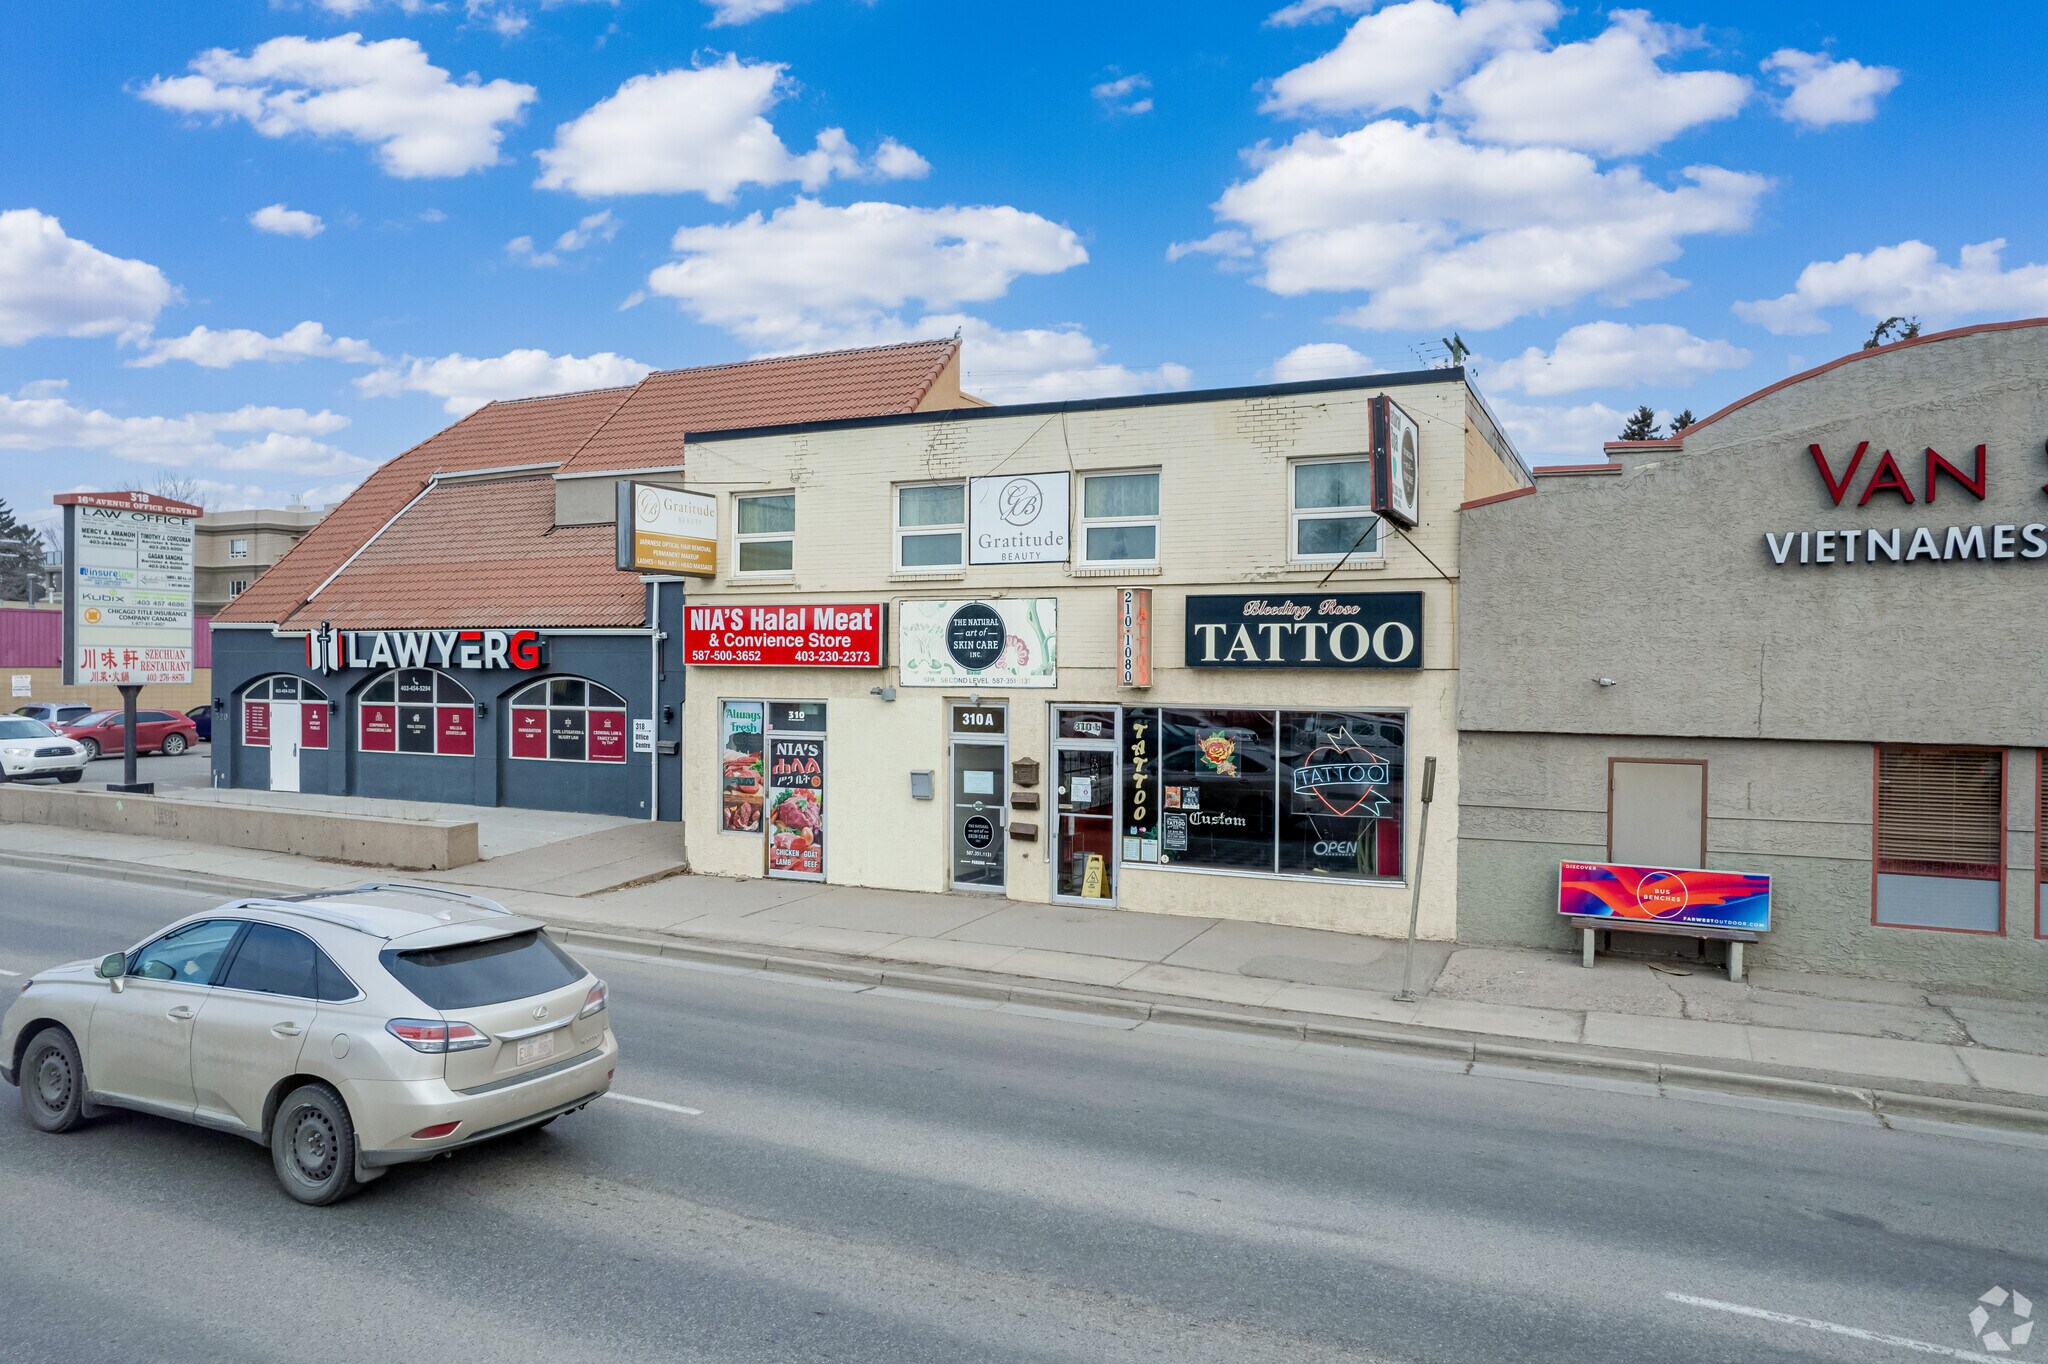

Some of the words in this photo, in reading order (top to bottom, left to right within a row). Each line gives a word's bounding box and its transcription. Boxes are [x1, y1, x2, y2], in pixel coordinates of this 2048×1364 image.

[1809, 440, 1986, 507] VAN
[130, 492, 150, 503] 318
[77, 496, 94, 504] 16th
[96, 498, 130, 508] AVENUE
[133, 502, 163, 512] OFFICE
[165, 506, 198, 516] CENTRE
[664, 498, 714, 518] Gratitude
[82, 508, 122, 519] LAW
[131, 512, 190, 526] OFFICE
[678, 517, 702, 526] BEAUTY
[82, 527, 102, 535] MERCY
[140, 533, 162, 541] TIMOTHY
[978, 531, 1064, 549] Gratitude
[640, 539, 661, 547] JAPANESE
[662, 540, 680, 548] OPTICAL
[692, 544, 712, 552] REMOVAL
[148, 552, 164, 560] GAGAN
[653, 550, 680, 558] PERMANENT
[681, 552, 699, 560] MAKEUP
[1001, 552, 1041, 561] BEAUTY
[693, 563, 712, 571] MASSAGE
[90, 568, 135, 578] insureline
[1242, 600, 1311, 620] Bleeding
[1318, 599, 1361, 616] Rose
[690, 608, 744, 631] NIA'S
[750, 608, 806, 631] Halal
[813, 608, 872, 631] Meat
[968, 618, 999, 626] NATURAL
[978, 628, 988, 637] of
[708, 634, 720, 647] &
[724, 632, 804, 648] Convience
[808, 632, 851, 648] Store
[953, 640, 974, 650] SKIN
[976, 640, 998, 650] CARE
[1194, 622, 1415, 663] TATTOO
[145, 649, 186, 660] SZECHUAN
[349, 630, 541, 670] LAWYERG
[692, 650, 761, 661] 587-500-3652
[80, 648, 139, 670] 川味軒
[794, 651, 870, 662] 403-230-2373
[140, 661, 191, 672] RESTAURANT
[216, 712, 228, 720] 320
[726, 708, 762, 722] Always
[788, 710, 805, 719] 310
[962, 713, 984, 726] 310
[985, 714, 994, 726] A
[636, 722, 646, 730] 318
[730, 722, 757, 732] Fresh
[776, 742, 819, 756] NIA'S
[1131, 723, 1148, 821] TATTOO
[1298, 765, 1385, 785] TATTOO
[1188, 811, 1246, 826] Custom
[776, 848, 800, 857] CHICKEN
[804, 850, 818, 858] GOAT
[1313, 841, 1358, 856] OPEN
[776, 858, 792, 866] LAMB
[804, 860, 818, 868] BEEF
[1643, 894, 1681, 902] BENCHES
[1682, 916, 1766, 928] FARWESTOUTDOOR.COM
